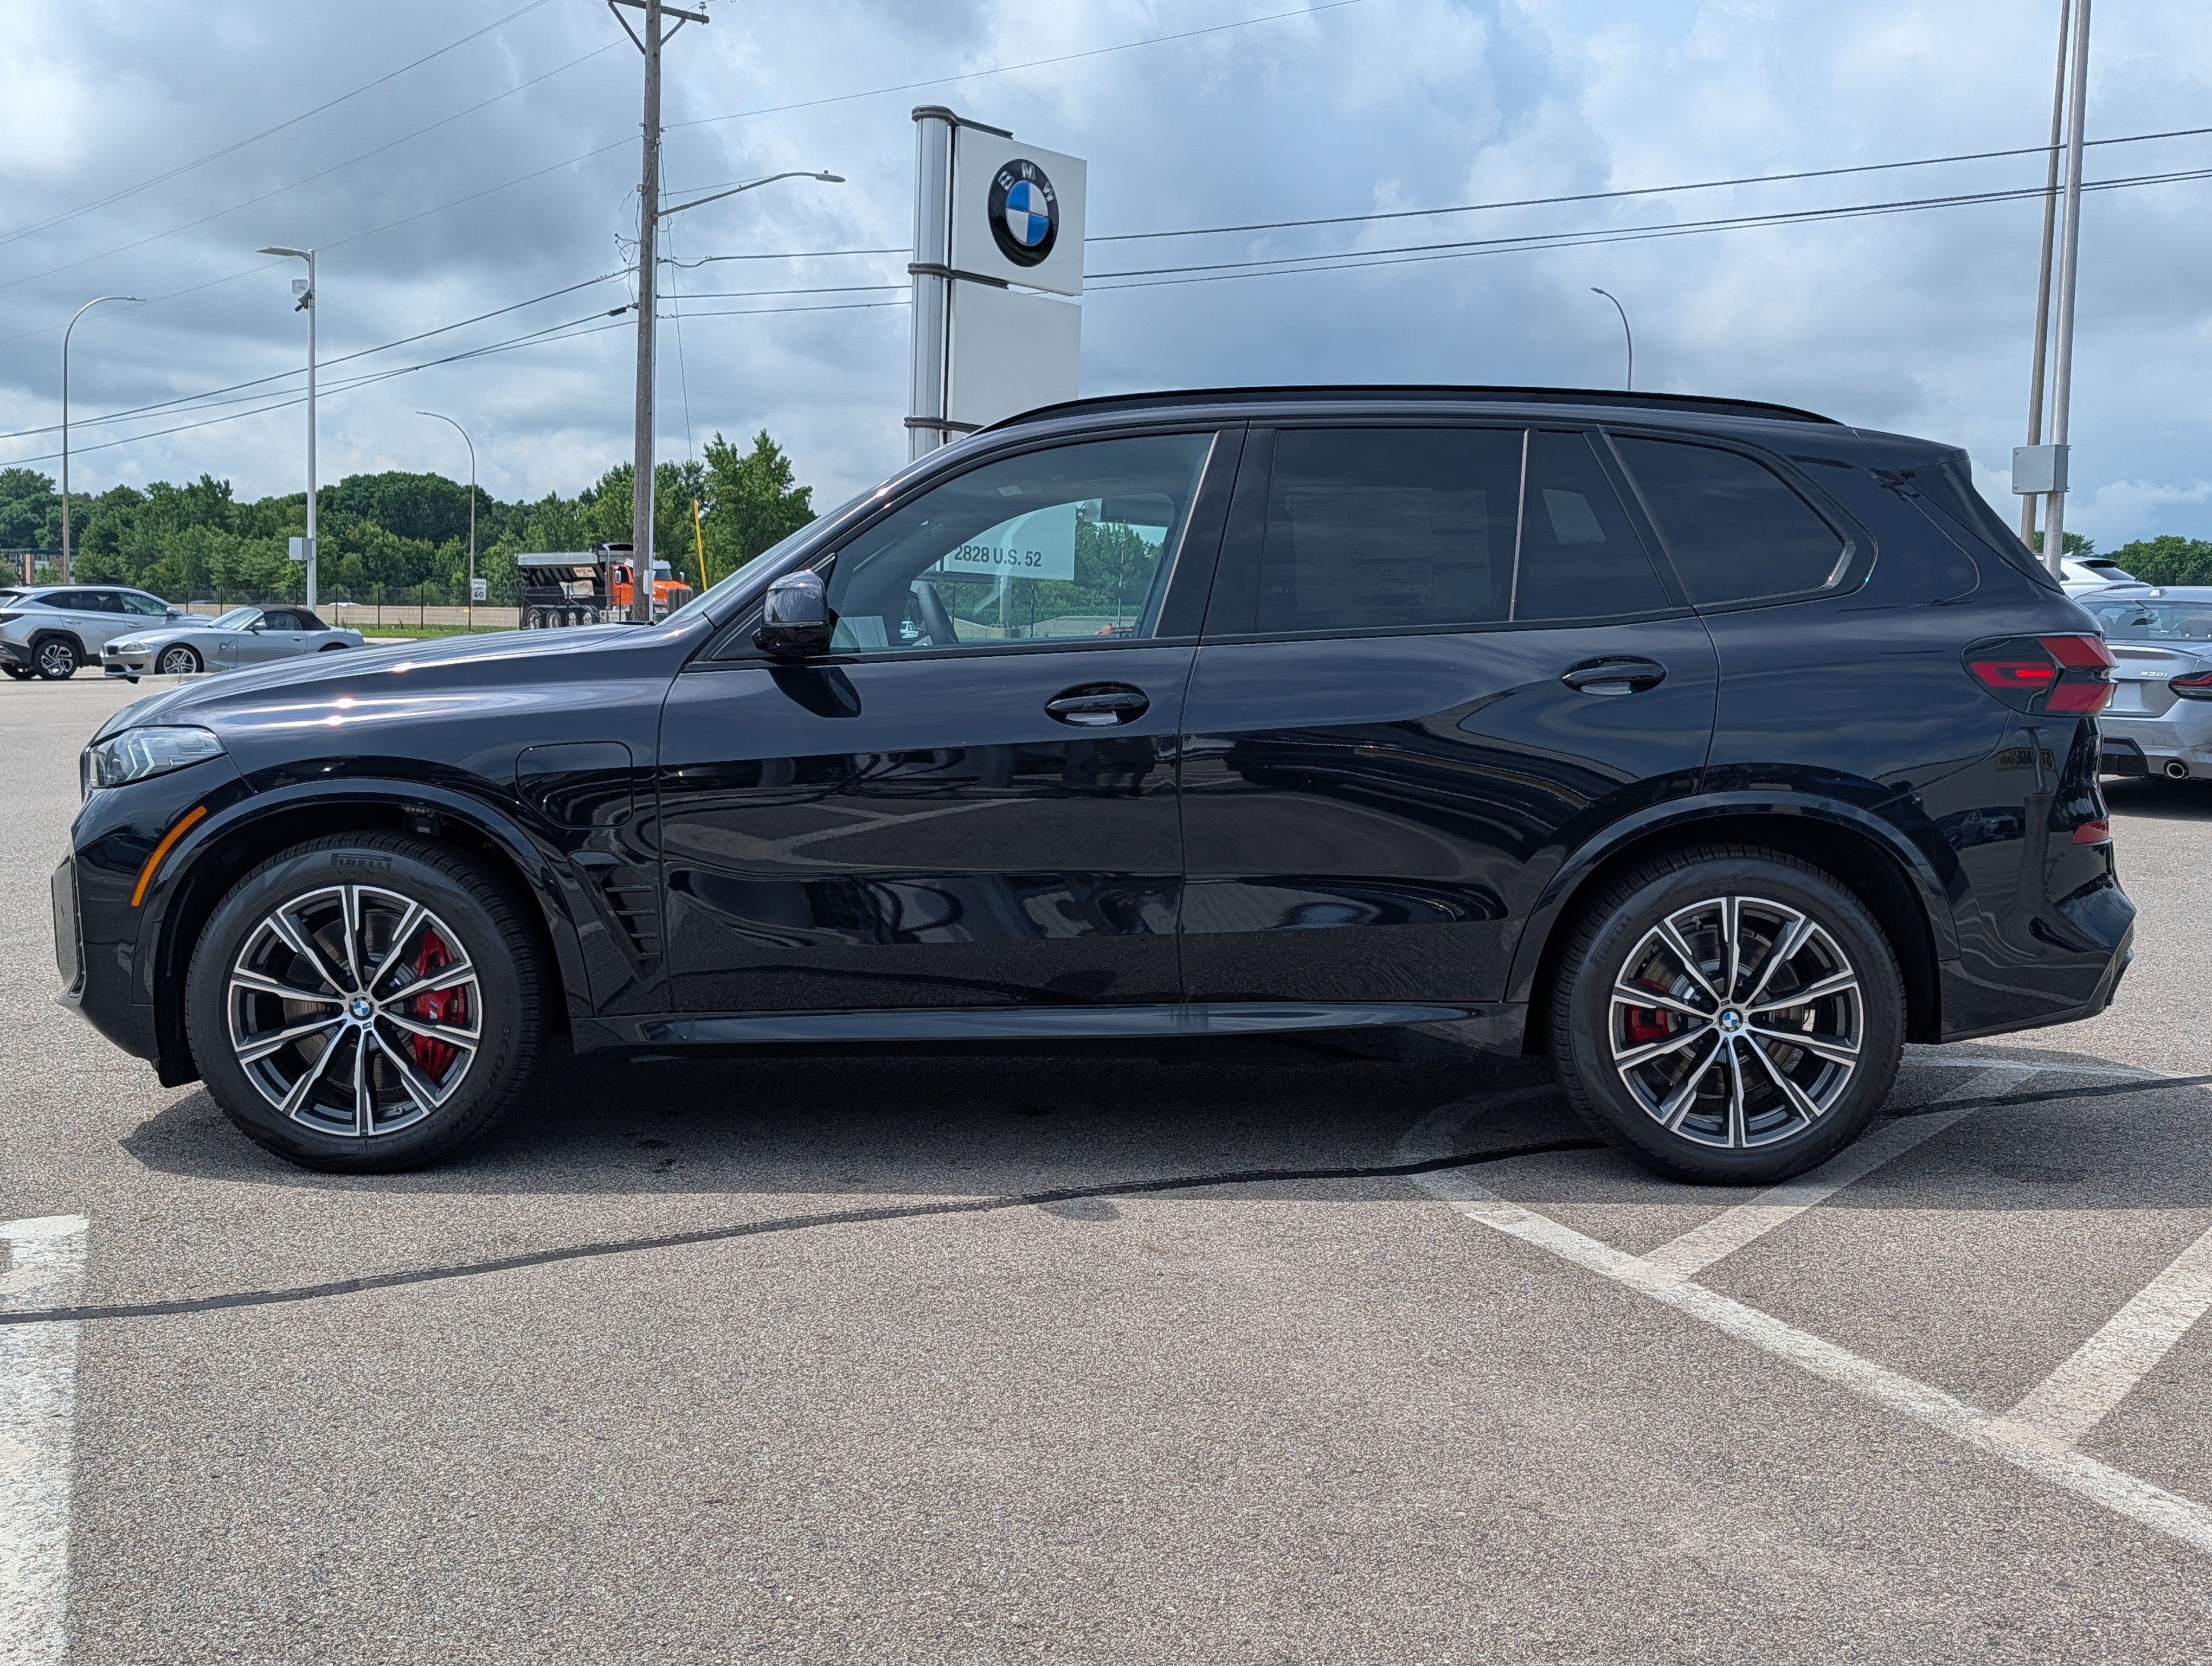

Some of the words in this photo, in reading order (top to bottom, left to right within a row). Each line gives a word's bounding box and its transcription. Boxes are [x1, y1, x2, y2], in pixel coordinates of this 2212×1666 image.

[998, 162, 1055, 202] BMW
[954, 544, 989, 563] 2828
[993, 547, 1021, 565] U.S.
[1025, 551, 1041, 567] 52
[330, 853, 393, 871] PIRELLI
